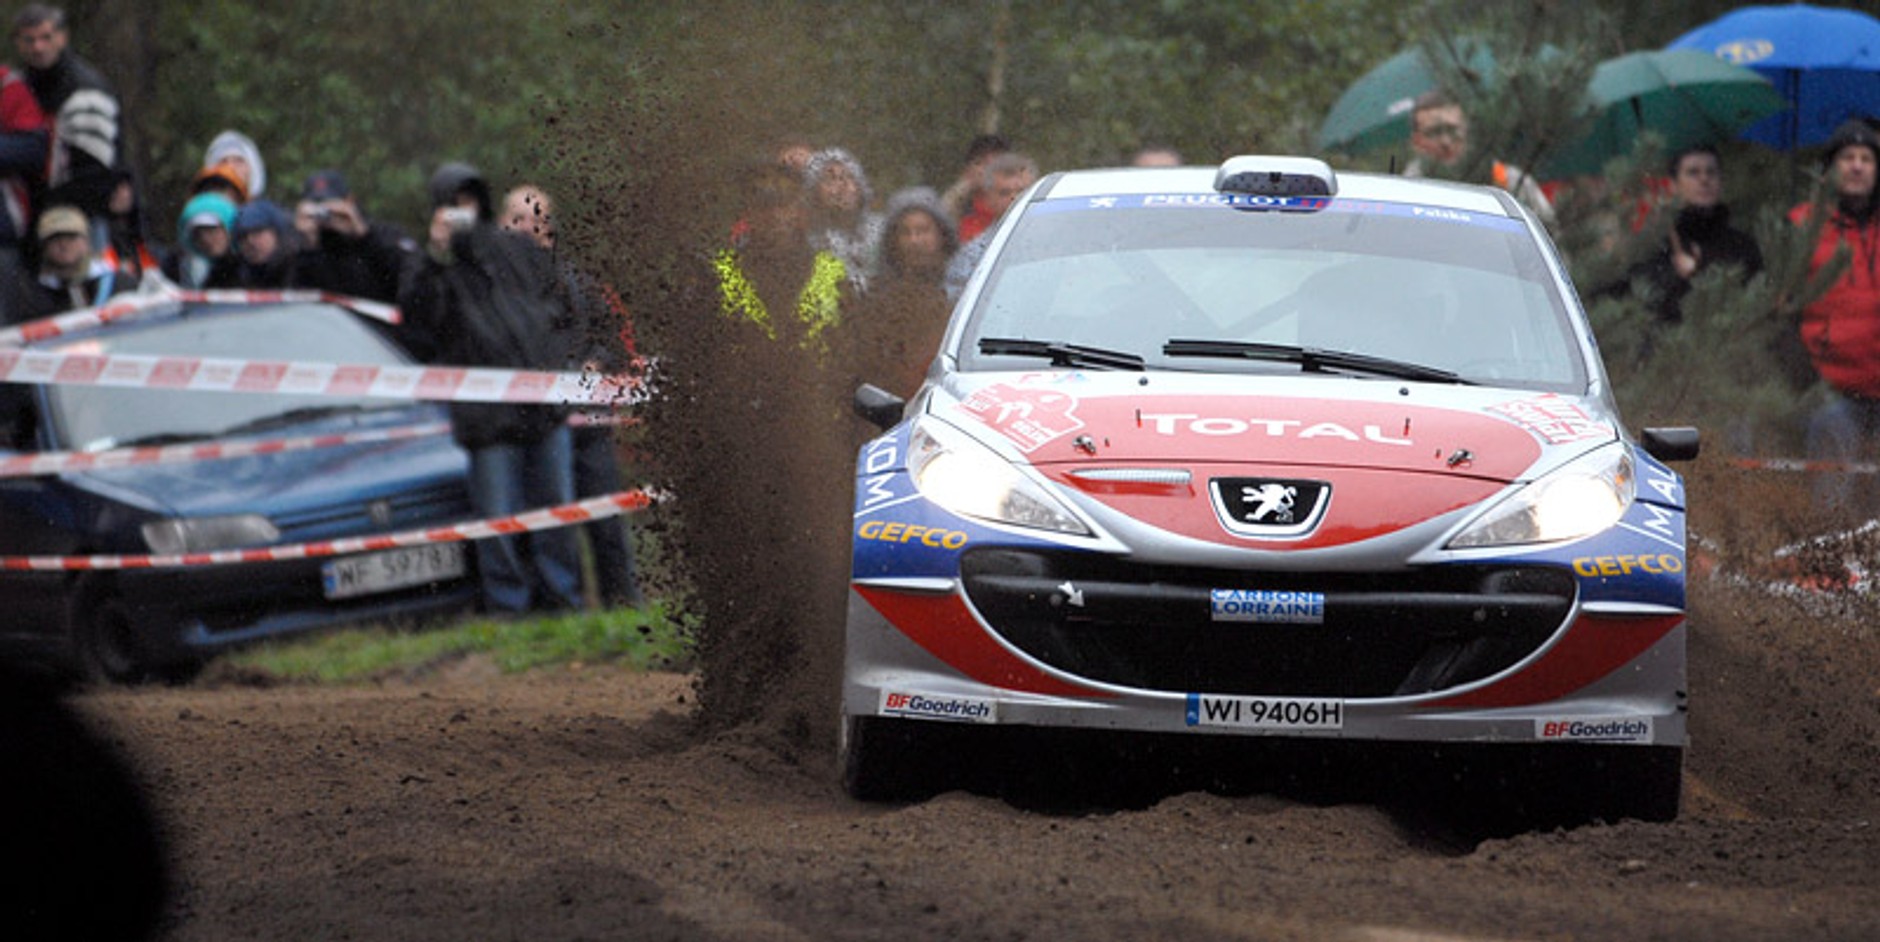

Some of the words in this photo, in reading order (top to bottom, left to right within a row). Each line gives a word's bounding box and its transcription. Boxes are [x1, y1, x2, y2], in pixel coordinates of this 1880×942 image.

[1143, 194, 1292, 206] PEUGEOT
[1140, 413, 1414, 446] TOTAL
[858, 521, 969, 549] GEFCO
[1572, 553, 1683, 577] GEFCO
[1210, 588, 1324, 602] CARBONE
[1211, 601, 1323, 616] LORRAINE
[885, 693, 990, 716] BFGoodrich
[1203, 698, 1241, 722] WI
[1250, 700, 1340, 724] 9406H
[1543, 721, 1648, 737] BFGoodrich
